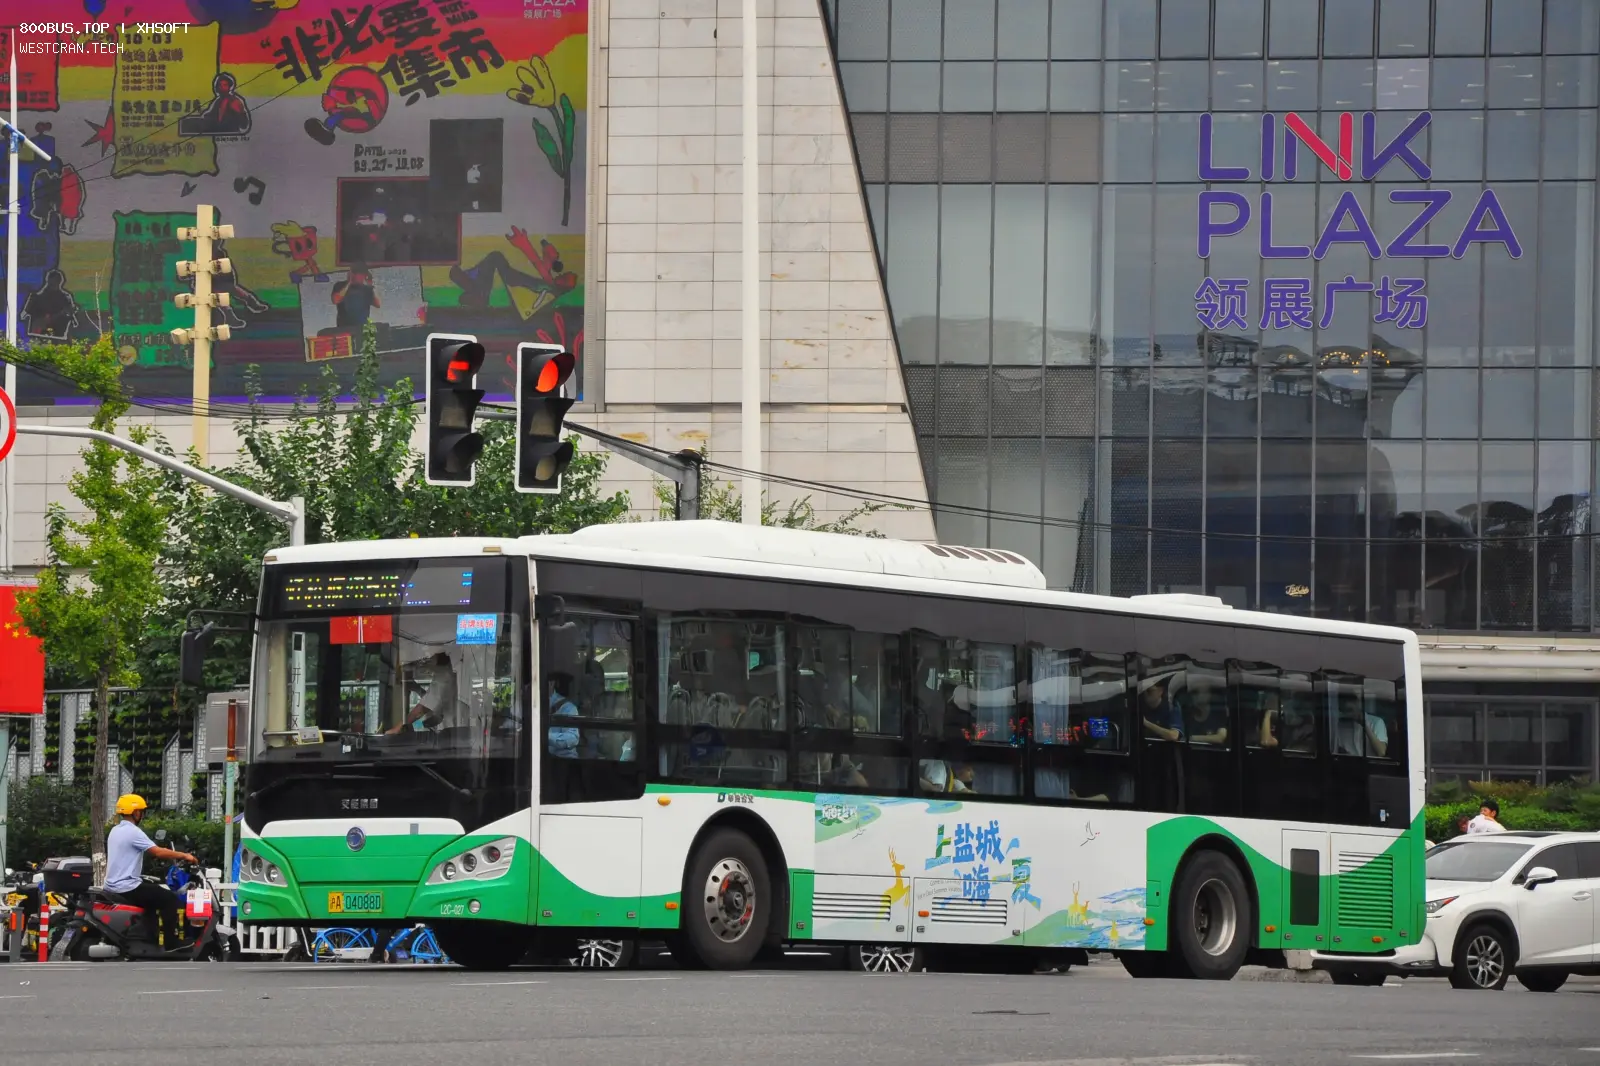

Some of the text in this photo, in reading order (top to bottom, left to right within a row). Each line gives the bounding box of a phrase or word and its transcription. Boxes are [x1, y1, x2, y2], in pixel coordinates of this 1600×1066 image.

[1197, 111, 1433, 181] LINK
[1197, 188, 1523, 259] PLAZA
[1194, 275, 1429, 330] 领展广场
[925, 819, 1006, 871] 上盐城
[440, 903, 465, 915] L2C-027
